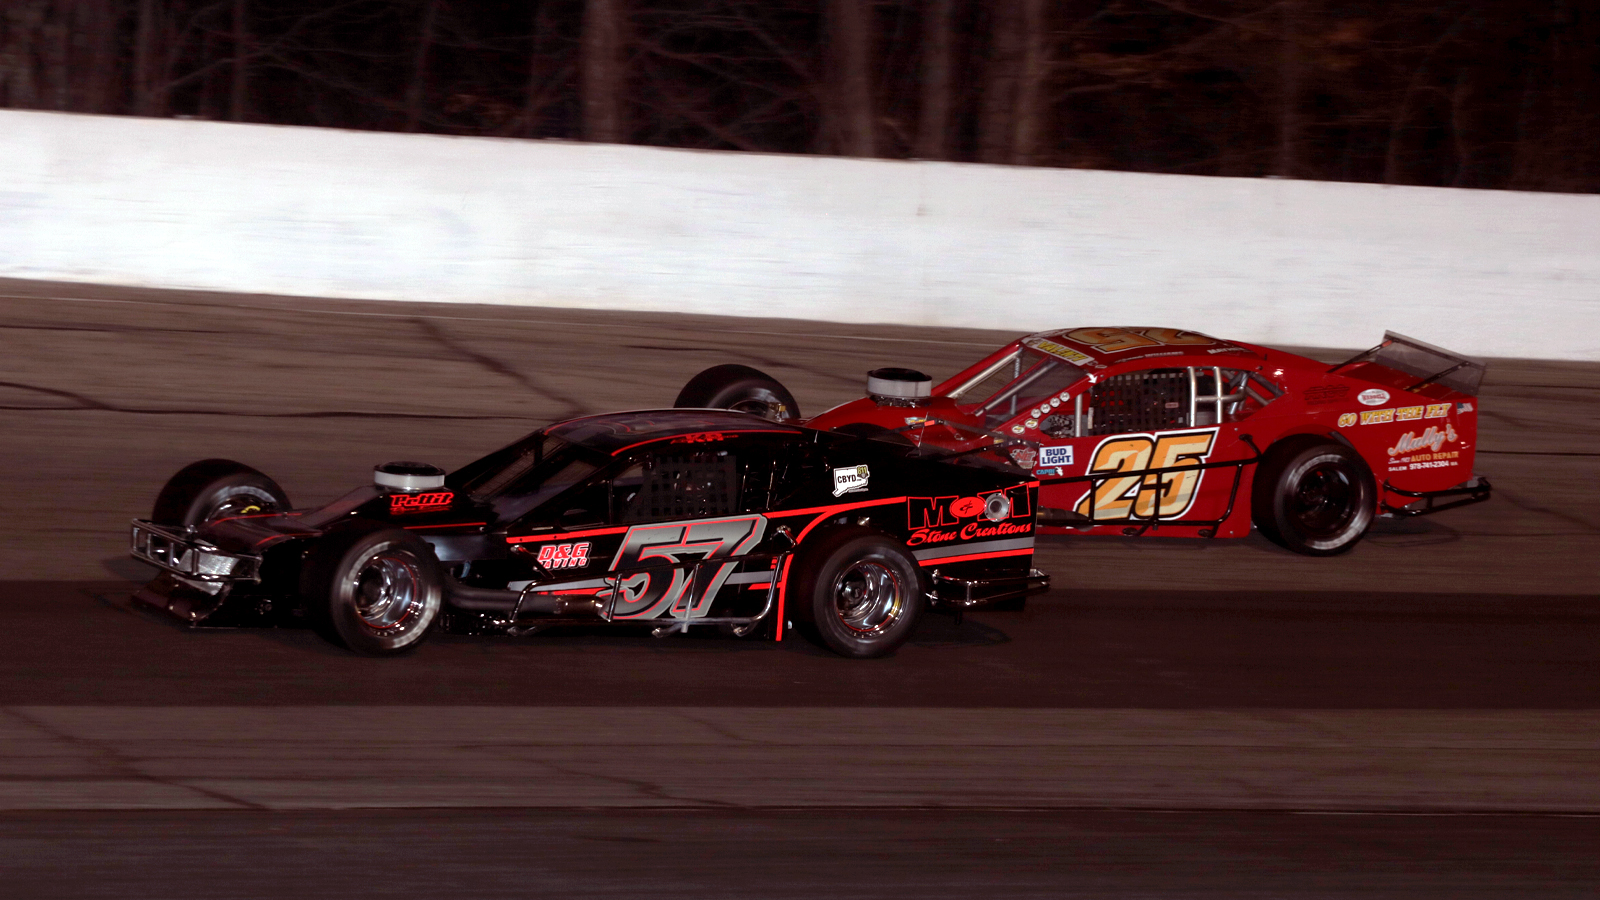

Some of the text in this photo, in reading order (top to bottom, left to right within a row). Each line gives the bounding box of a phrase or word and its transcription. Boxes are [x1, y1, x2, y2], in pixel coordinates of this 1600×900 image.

[1338, 403, 1452, 427] GO WITH THE FLY
[1388, 424, 1457, 456] Mully's
[1042, 455, 1071, 464] LIGHT
[1046, 448, 1067, 457] BUD
[1411, 454, 1431, 462] AUTO
[1433, 451, 1459, 460] REPAIR
[837, 474, 857, 483] CBYD
[1072, 427, 1220, 521] 25
[906, 521, 1032, 547] Stone Creations
[537, 542, 590, 561] D&G
[596, 513, 767, 620] 57
